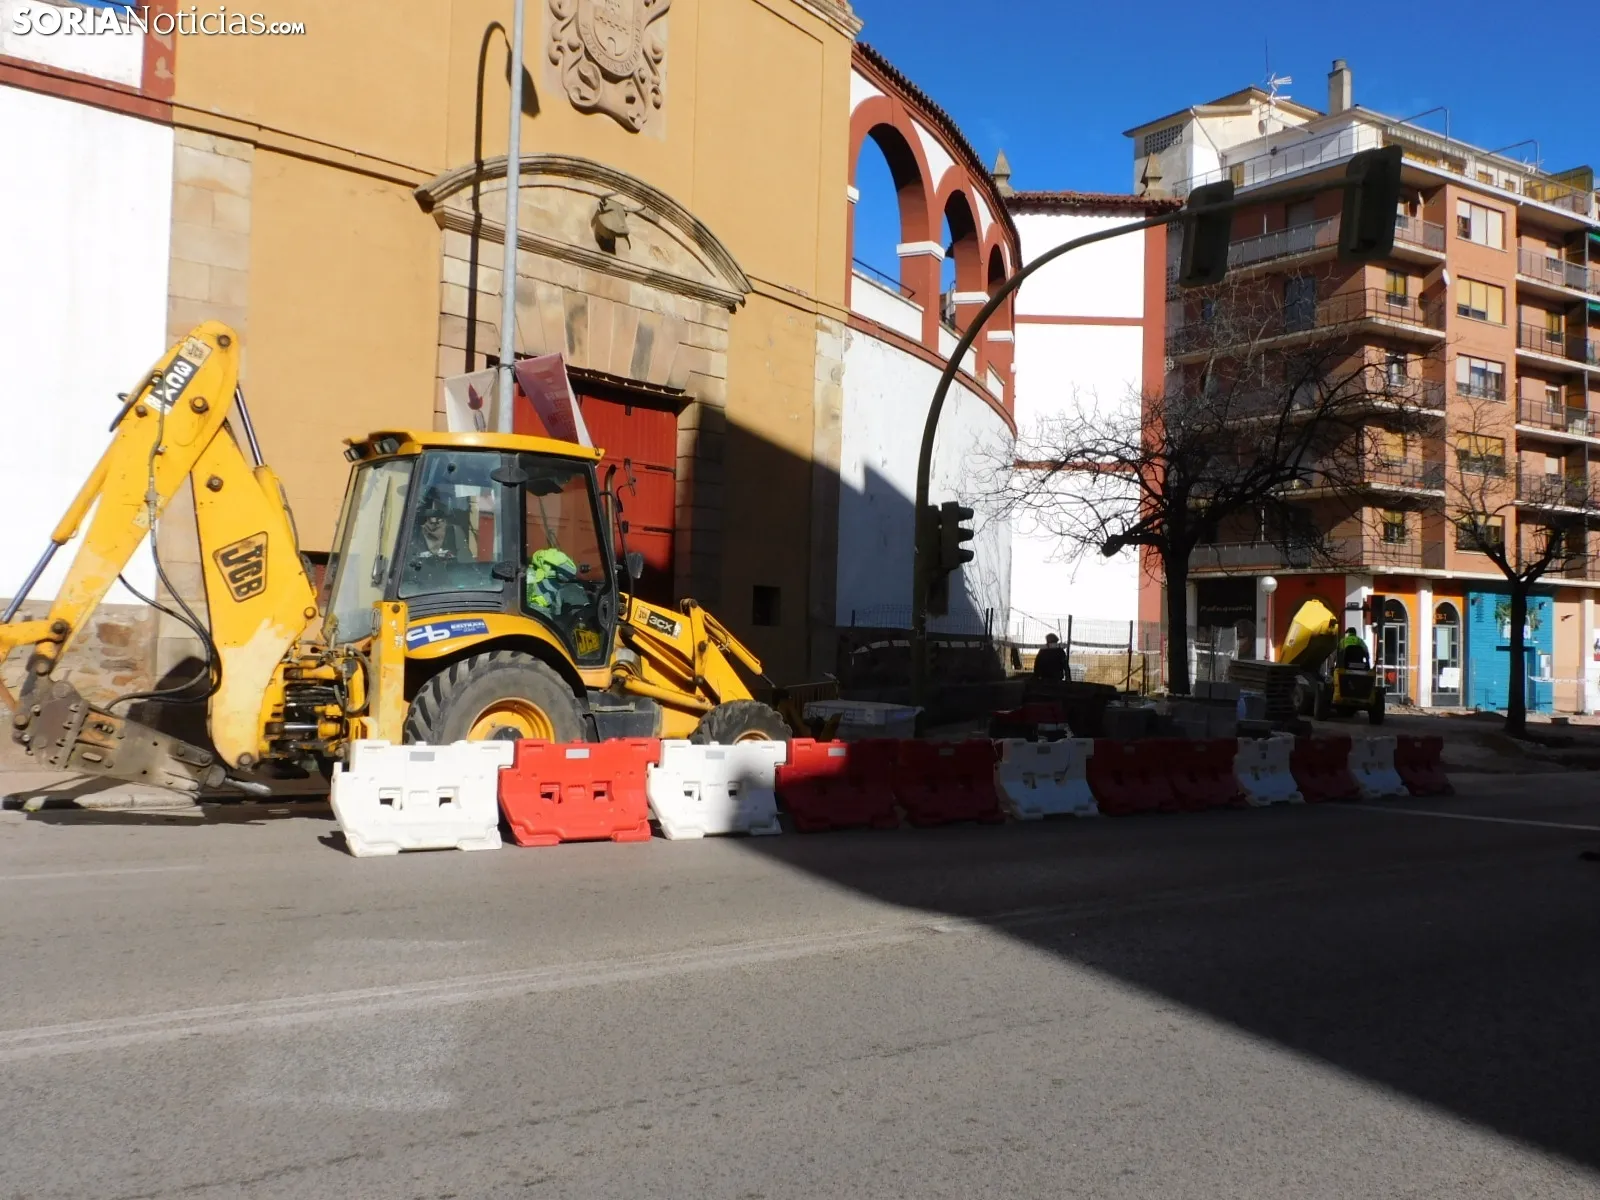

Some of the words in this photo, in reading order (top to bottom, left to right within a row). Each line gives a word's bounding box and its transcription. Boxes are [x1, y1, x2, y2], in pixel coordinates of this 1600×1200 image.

[155, 360, 193, 401] 3CX
[220, 543, 265, 599] JCB
[649, 615, 673, 632] 3CX
[577, 631, 599, 654] JCB
